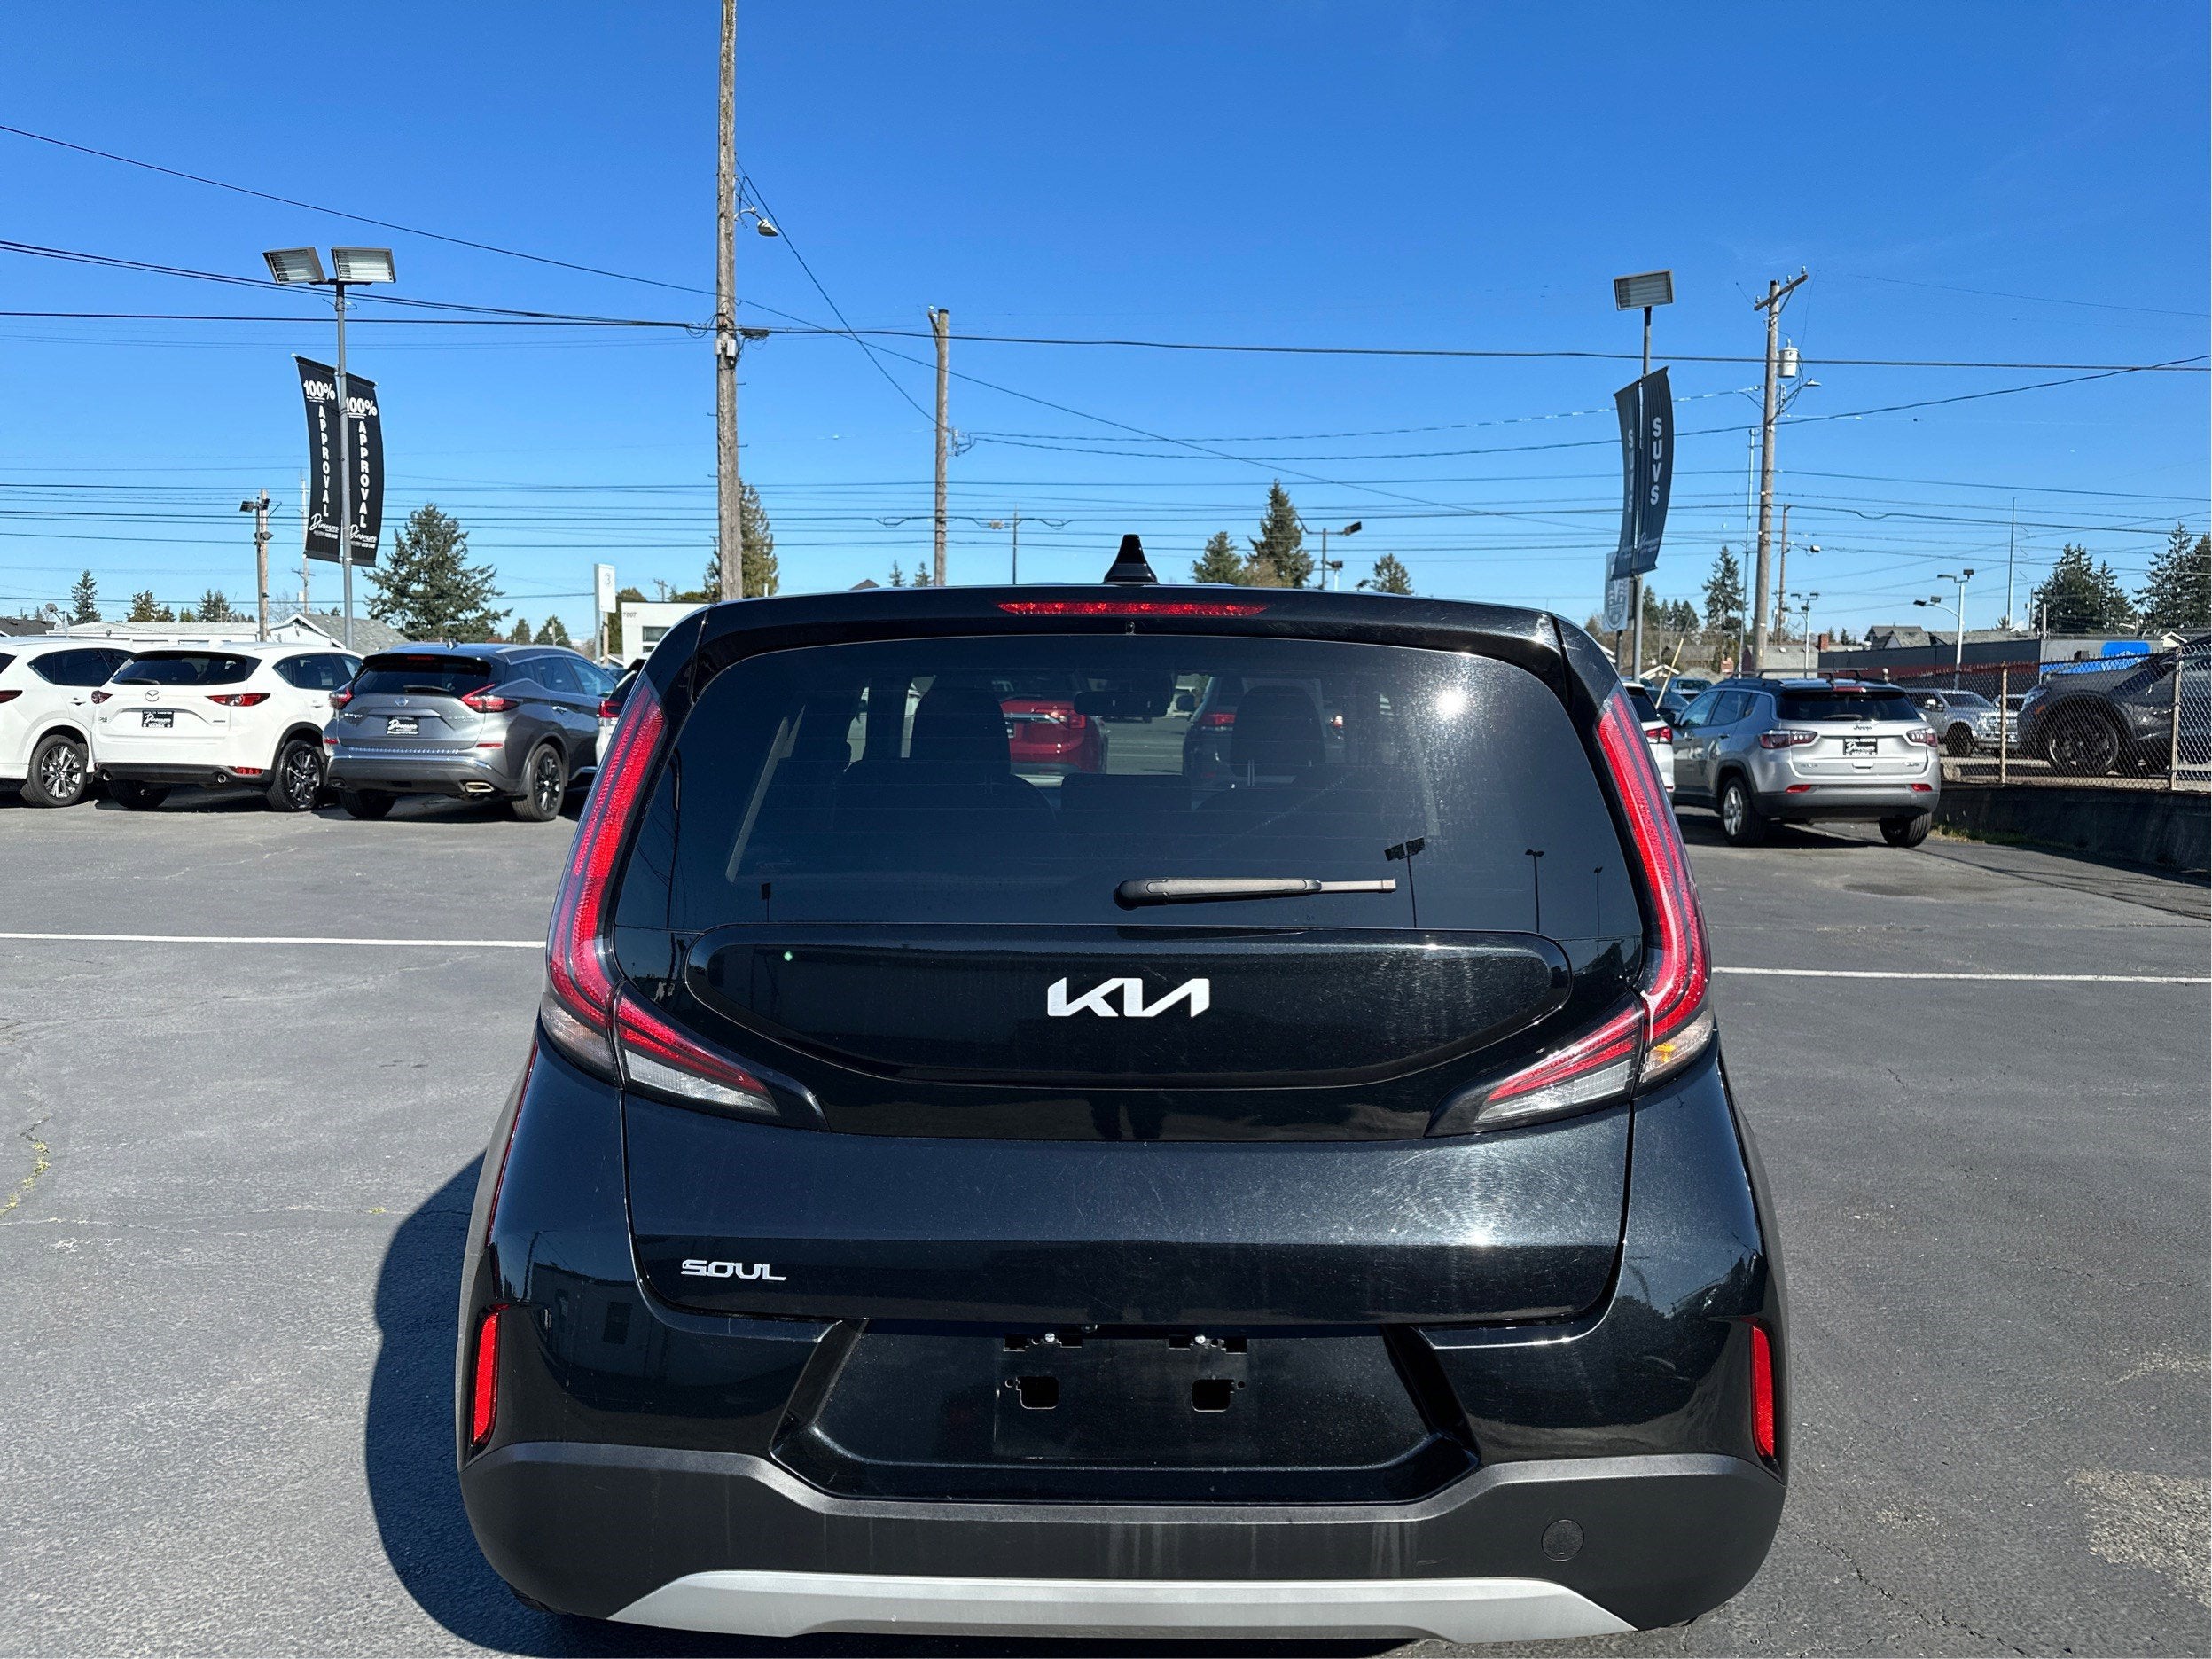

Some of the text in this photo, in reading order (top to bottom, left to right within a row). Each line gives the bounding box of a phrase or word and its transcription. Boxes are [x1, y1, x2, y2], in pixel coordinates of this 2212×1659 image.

[303, 380, 336, 401] 100%
[318, 405, 330, 517] APPROVAL
[358, 420, 370, 528] APPROVAL
[1650, 417, 1662, 505] SUVS
[1047, 977, 1210, 1018] KIA
[680, 1259, 787, 1281] SOUL
